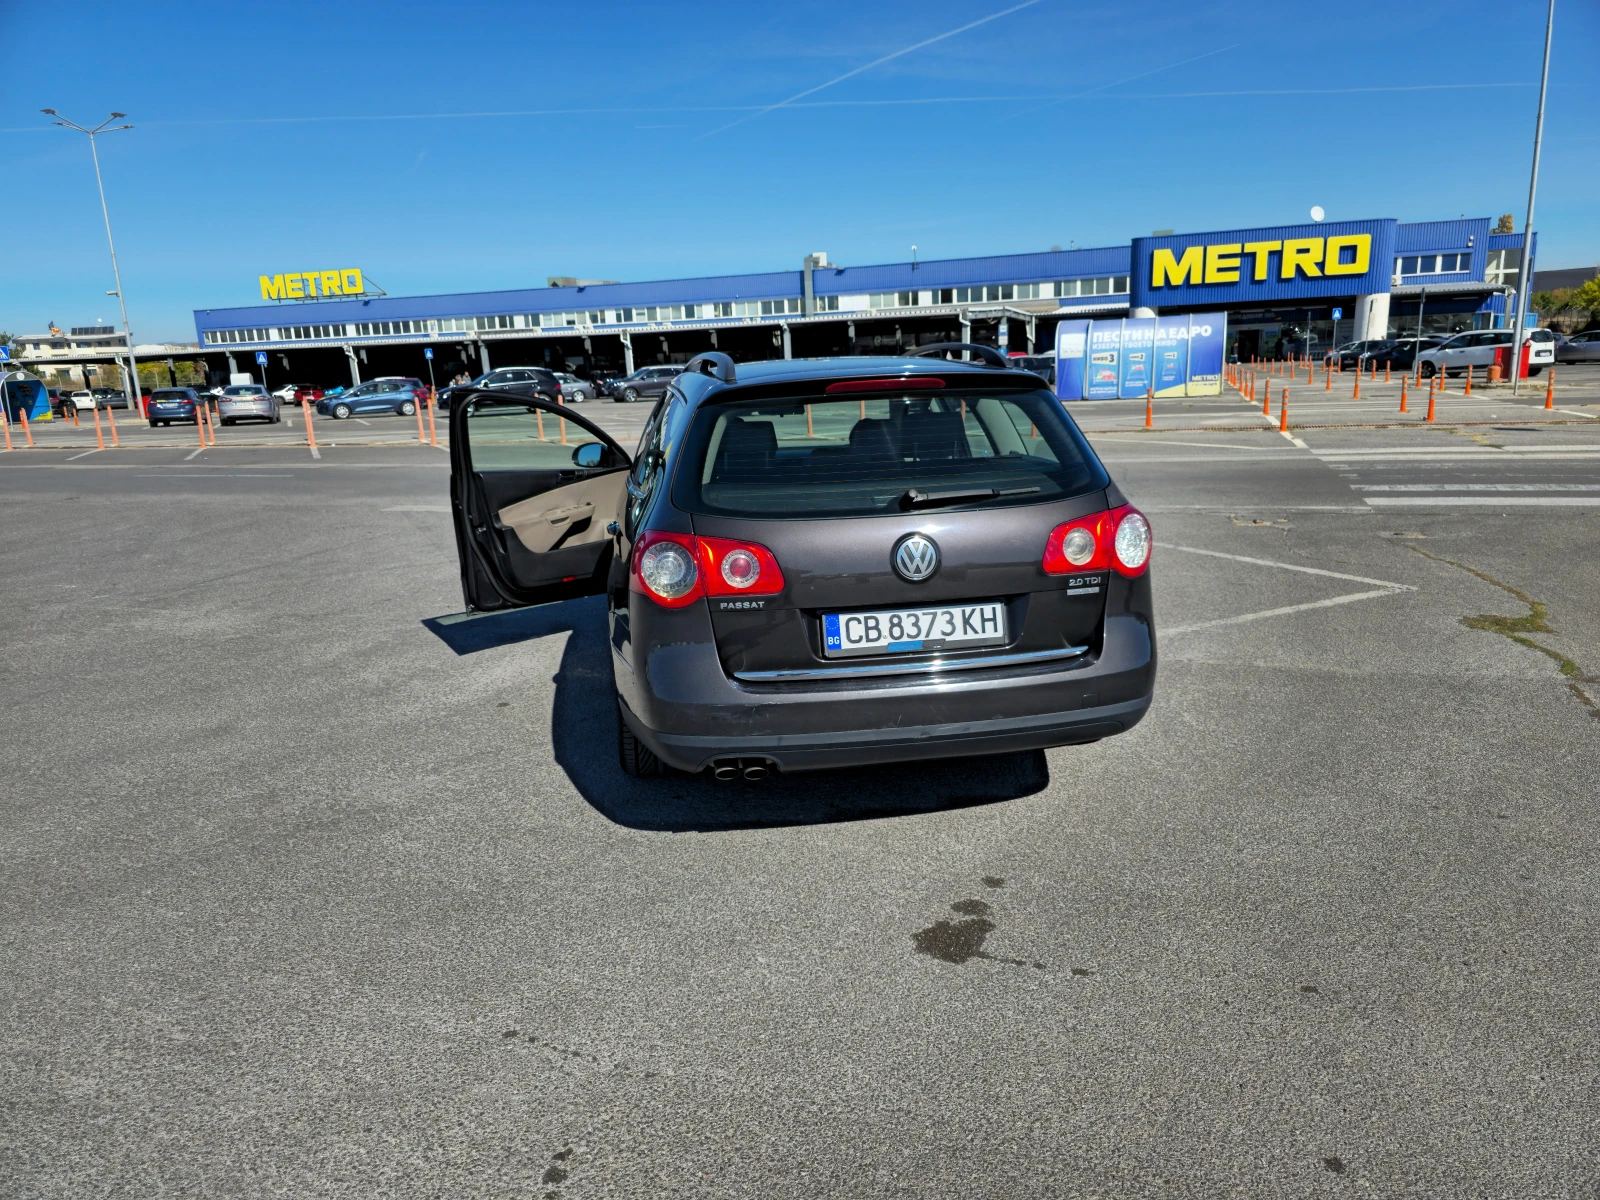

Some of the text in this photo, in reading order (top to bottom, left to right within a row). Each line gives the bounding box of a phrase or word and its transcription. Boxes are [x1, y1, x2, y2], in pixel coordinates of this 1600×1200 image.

[1152, 234, 1372, 287] METRO
[259, 268, 364, 300] METRO
[1092, 325, 1212, 343] ПЕСТИ НА ЕДРО
[1109, 353, 1115, 362] 3
[1192, 374, 1218, 382] METRO
[1084, 576, 1101, 584] TDI
[720, 601, 765, 610] PASSAT
[845, 606, 998, 644] CB 8373 KH
[827, 636, 840, 645] BG
